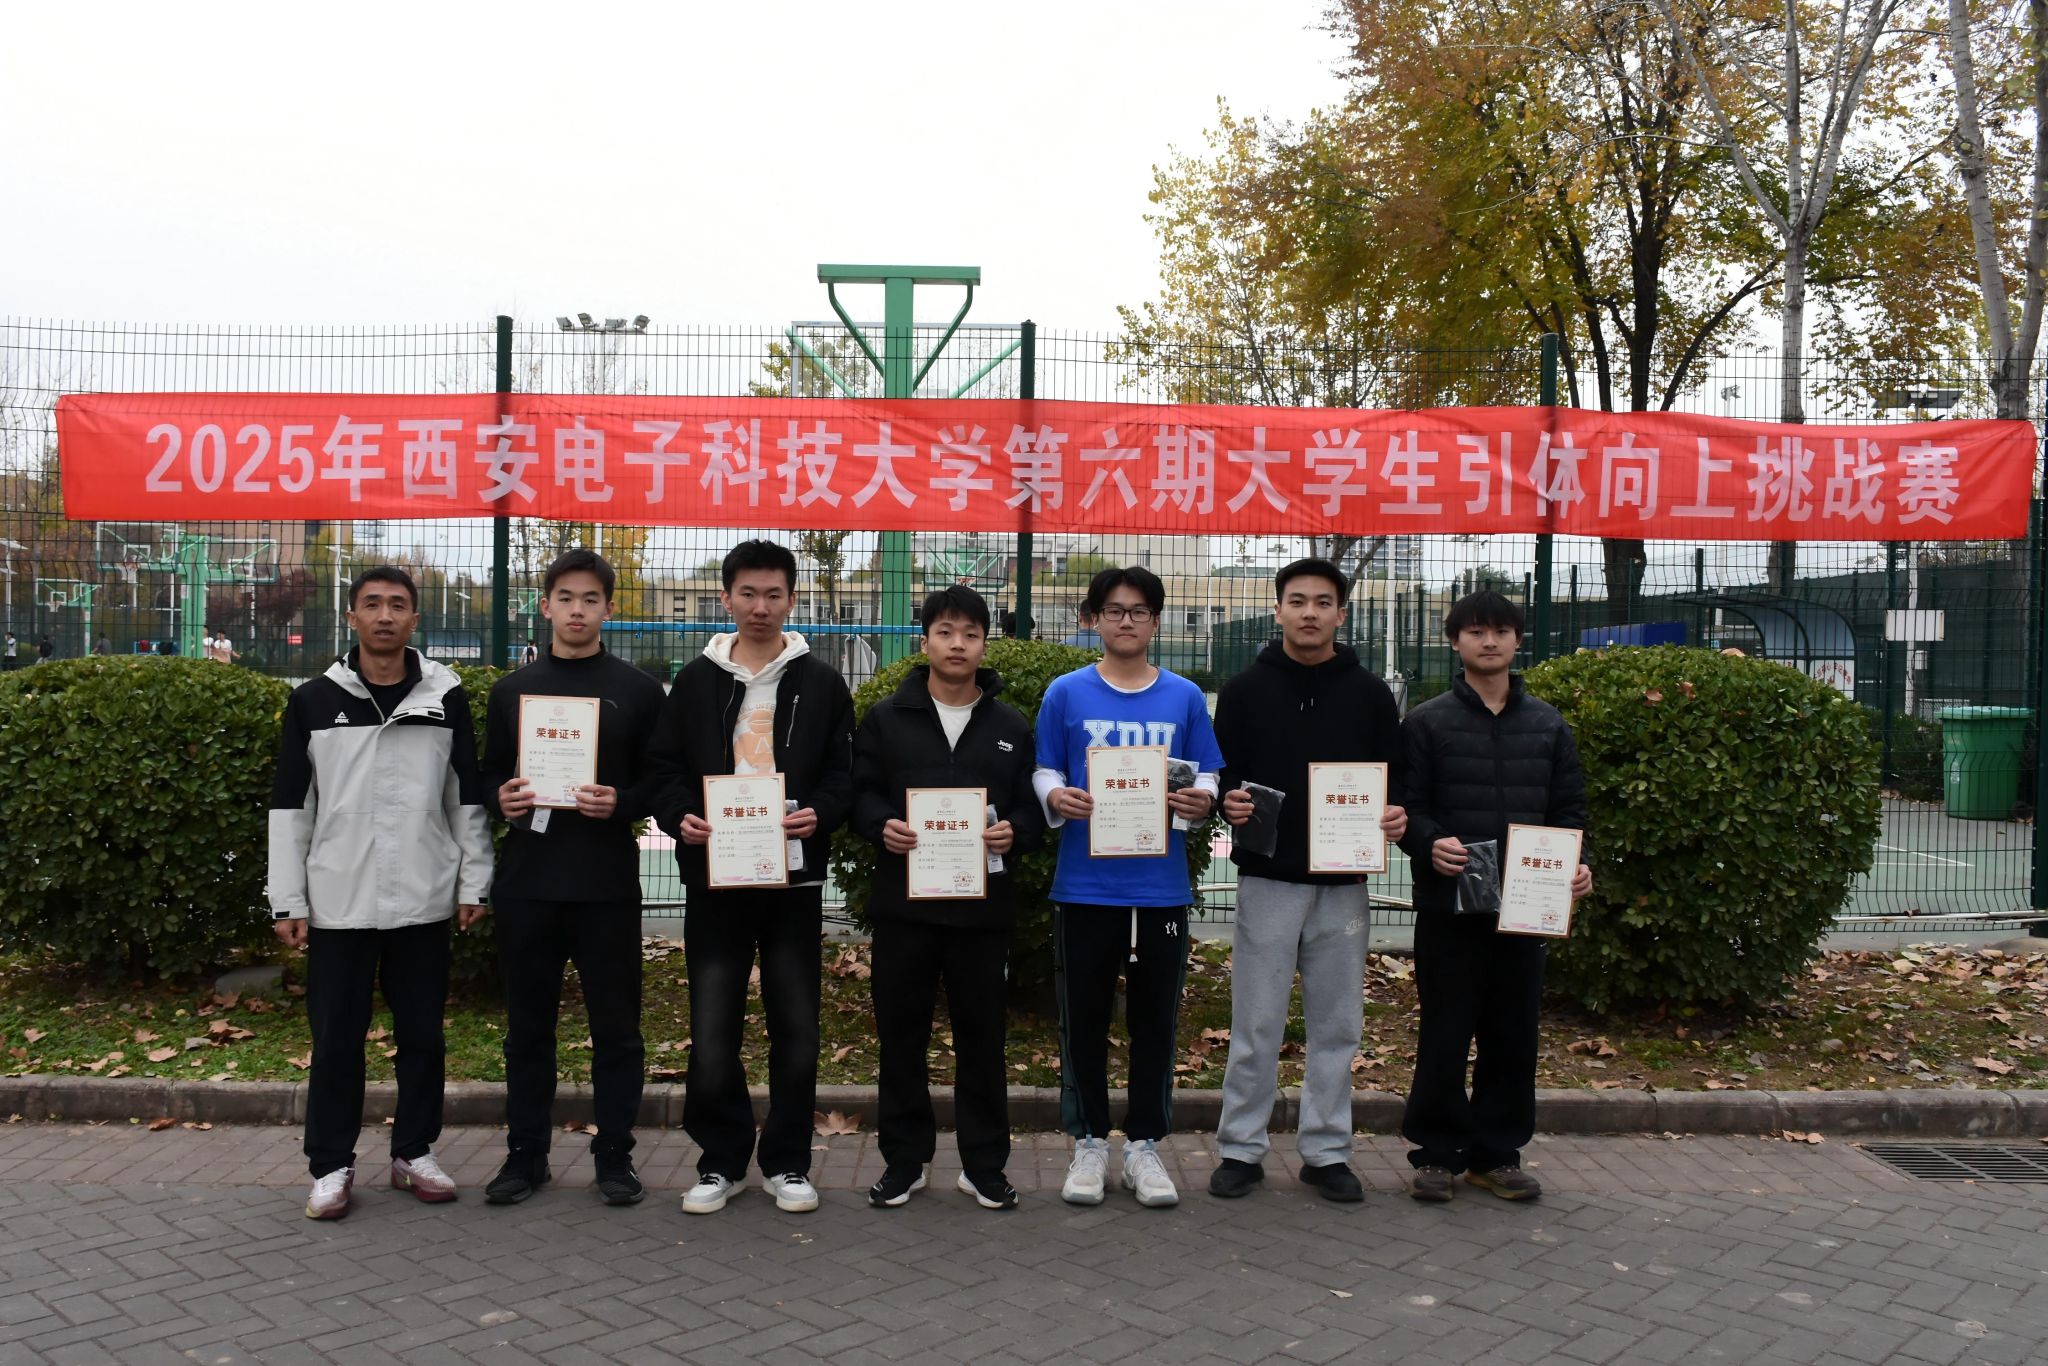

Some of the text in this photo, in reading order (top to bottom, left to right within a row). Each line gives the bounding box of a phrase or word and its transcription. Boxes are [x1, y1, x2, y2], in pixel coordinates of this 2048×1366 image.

[145, 414, 1960, 525] 2025年西安电子科技大学第六期大学生引体向上挑战赛
[536, 727, 581, 740] 荣誉证书
[1083, 719, 1177, 757] XDU
[1105, 778, 1150, 790] 荣誉证书
[1325, 793, 1370, 805] 荣誉证书
[722, 806, 768, 818] 荣誉证书
[924, 820, 969, 831] 荣誉证书
[1521, 856, 1563, 870] 荣誉证书
